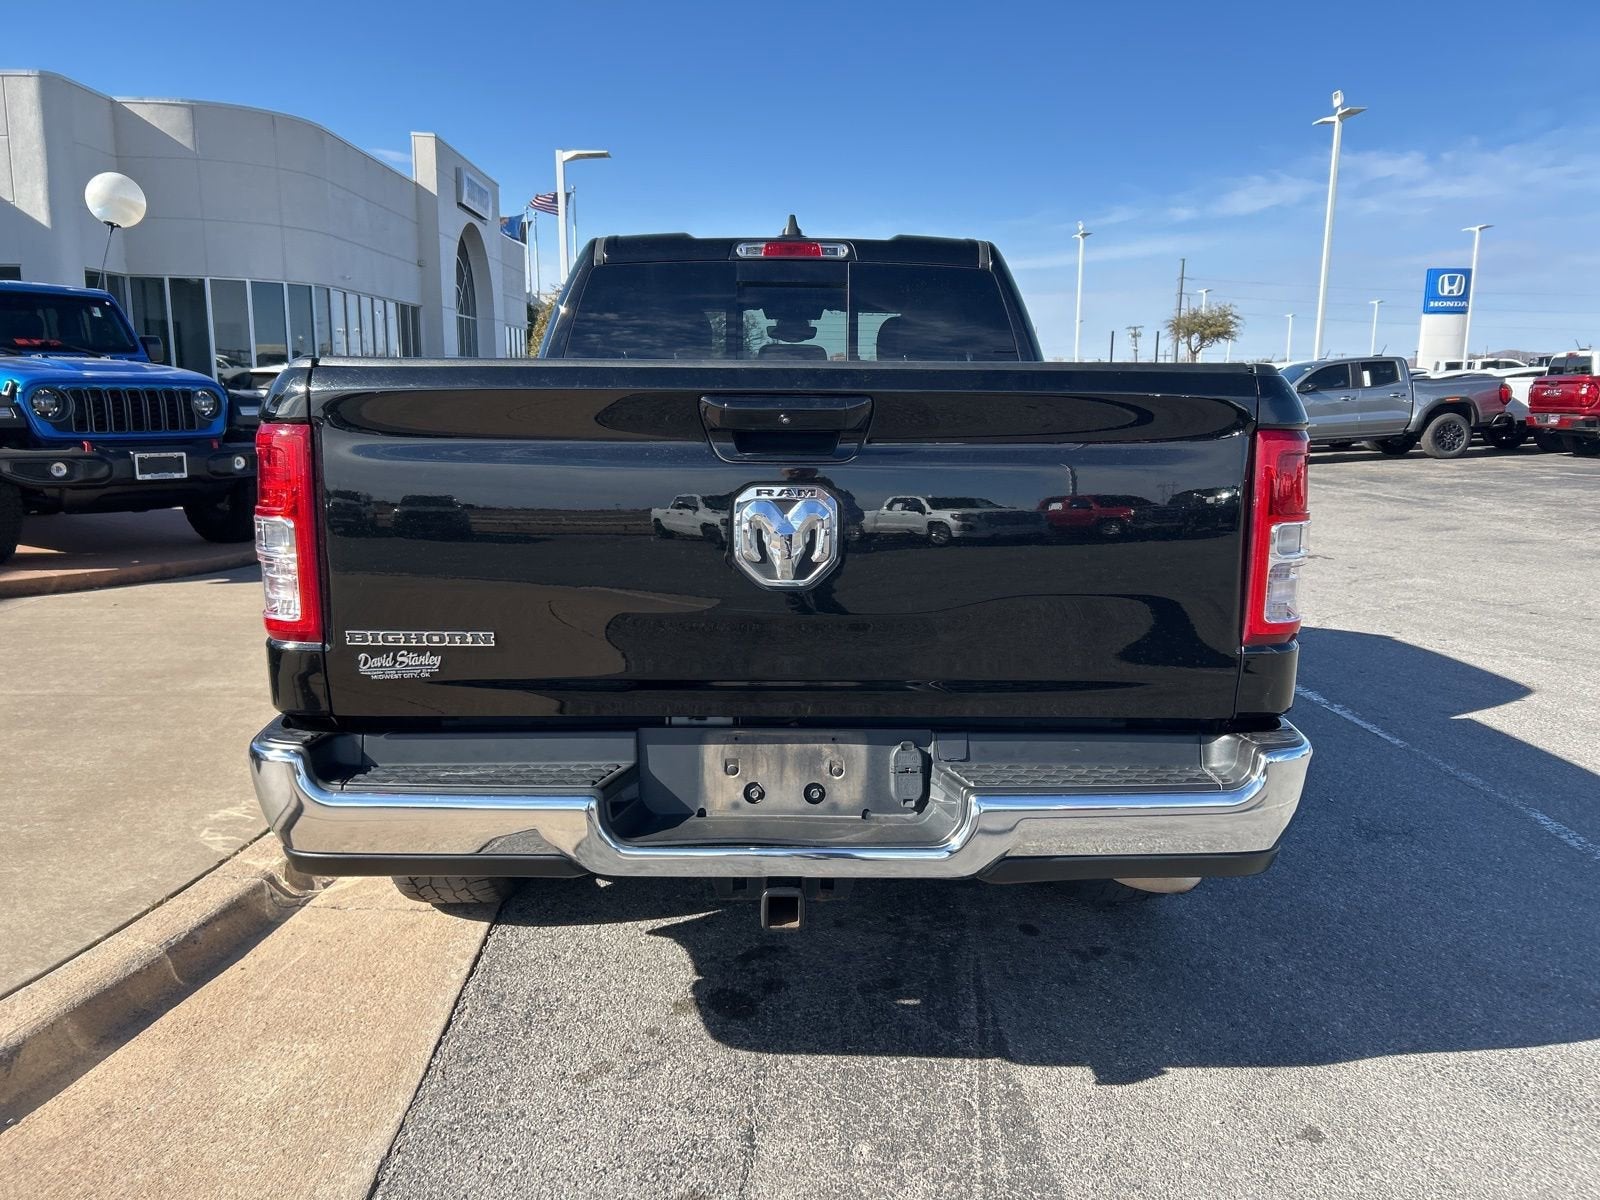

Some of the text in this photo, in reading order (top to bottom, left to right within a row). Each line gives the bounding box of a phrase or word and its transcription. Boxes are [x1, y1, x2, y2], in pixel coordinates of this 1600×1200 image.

[755, 488, 818, 498] RAM
[345, 631, 495, 646] BIGHORN
[358, 650, 441, 669] David Stanley
